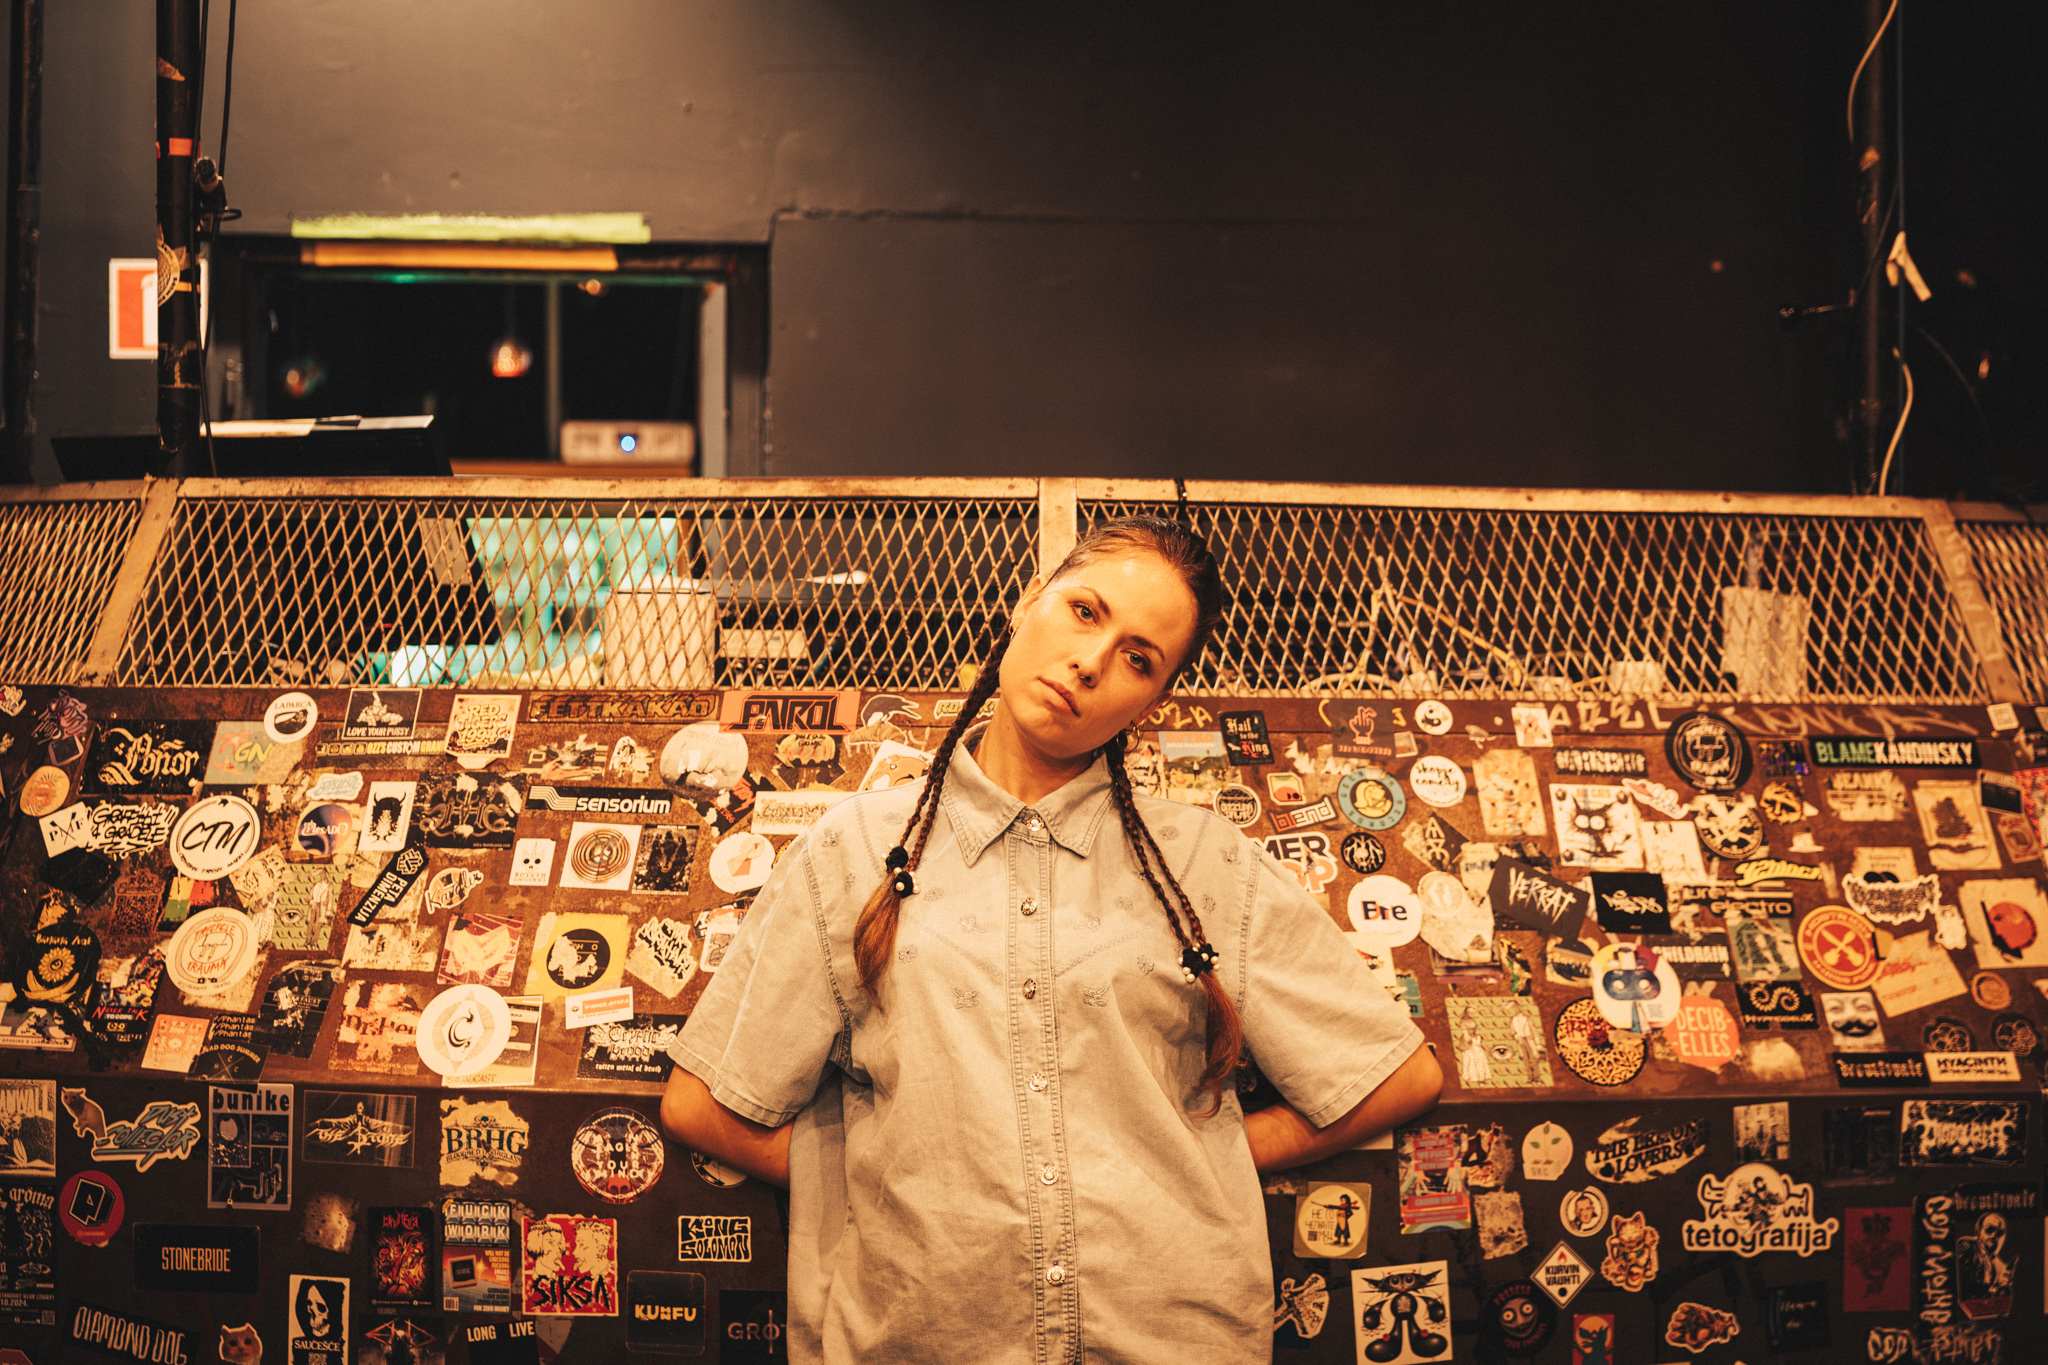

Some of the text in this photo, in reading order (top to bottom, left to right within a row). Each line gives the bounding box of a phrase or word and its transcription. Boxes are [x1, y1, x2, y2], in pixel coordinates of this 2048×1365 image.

[467, 703, 500, 717] RED
[529, 694, 716, 718] FETTKAKAO
[724, 694, 851, 732] PATROL
[347, 726, 410, 737] LOVE YOUR PUSSY
[459, 728, 502, 746] 1994
[576, 795, 671, 814] sensorium
[181, 821, 251, 855] CTM
[354, 871, 399, 923] DIMENZIJA
[384, 873, 408, 905] PETA
[1509, 867, 1577, 924] VERRAT
[212, 1089, 290, 1112] bunike
[1615, 1145, 1682, 1176] LOVERS
[449, 1204, 508, 1217] FUCK
[448, 1223, 508, 1237] WORK
[1686, 1223, 1828, 1255] tetografija
[162, 1246, 232, 1272] STONEBRIDE
[681, 1235, 749, 1260] SOLOMON
[1545, 1264, 1580, 1276] KURVIN
[73, 1306, 188, 1365] DIAMOND DOG
[467, 1321, 536, 1342] LONG LIVE
